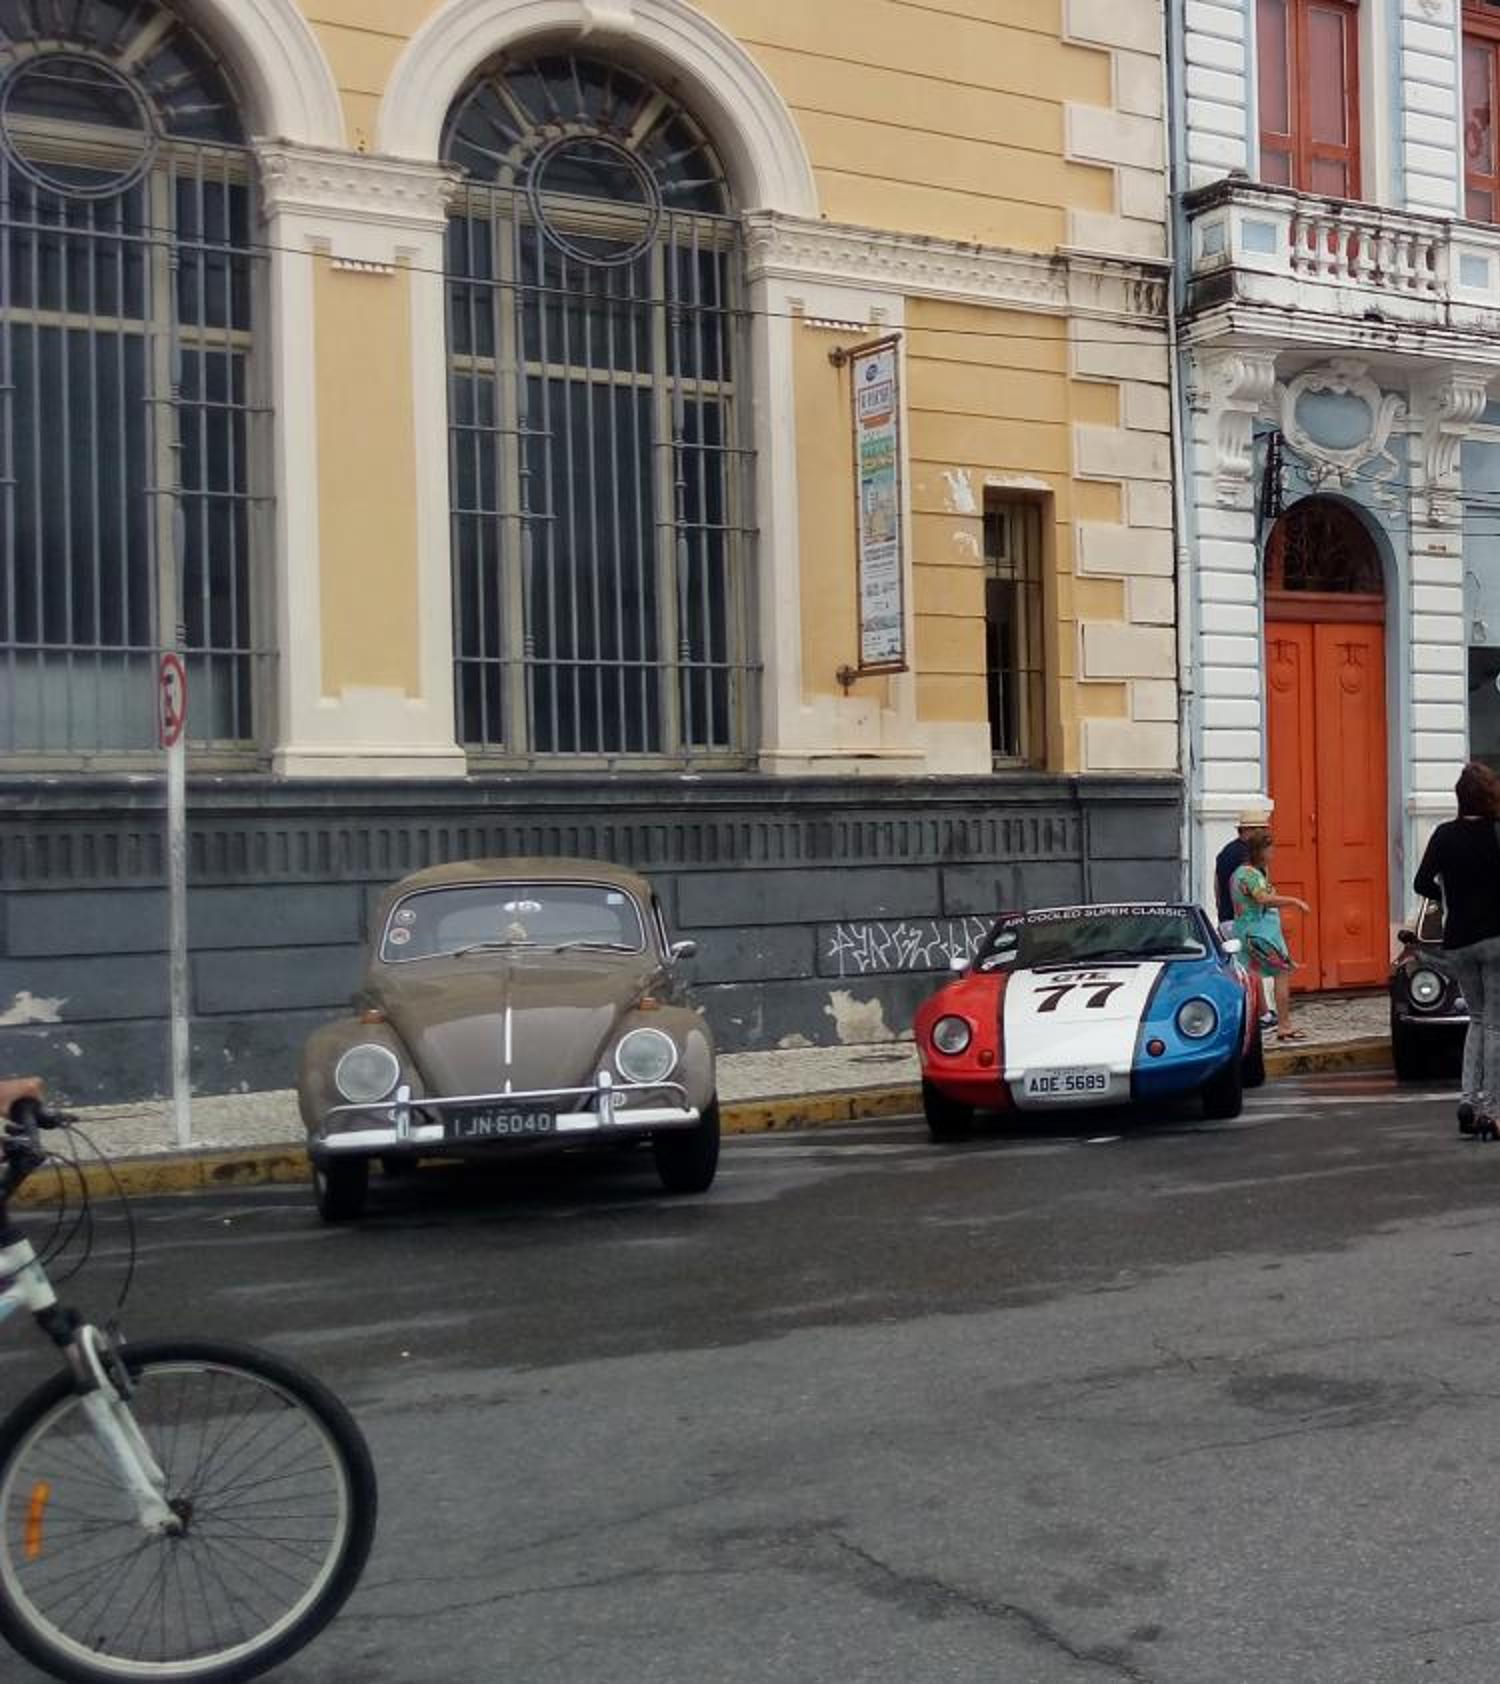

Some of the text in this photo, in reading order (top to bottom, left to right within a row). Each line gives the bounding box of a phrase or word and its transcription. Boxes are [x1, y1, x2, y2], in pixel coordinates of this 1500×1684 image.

[1004, 906, 1188, 928] AIR COOLED SUPER CLASSIC
[1034, 982, 1124, 1013] 77
